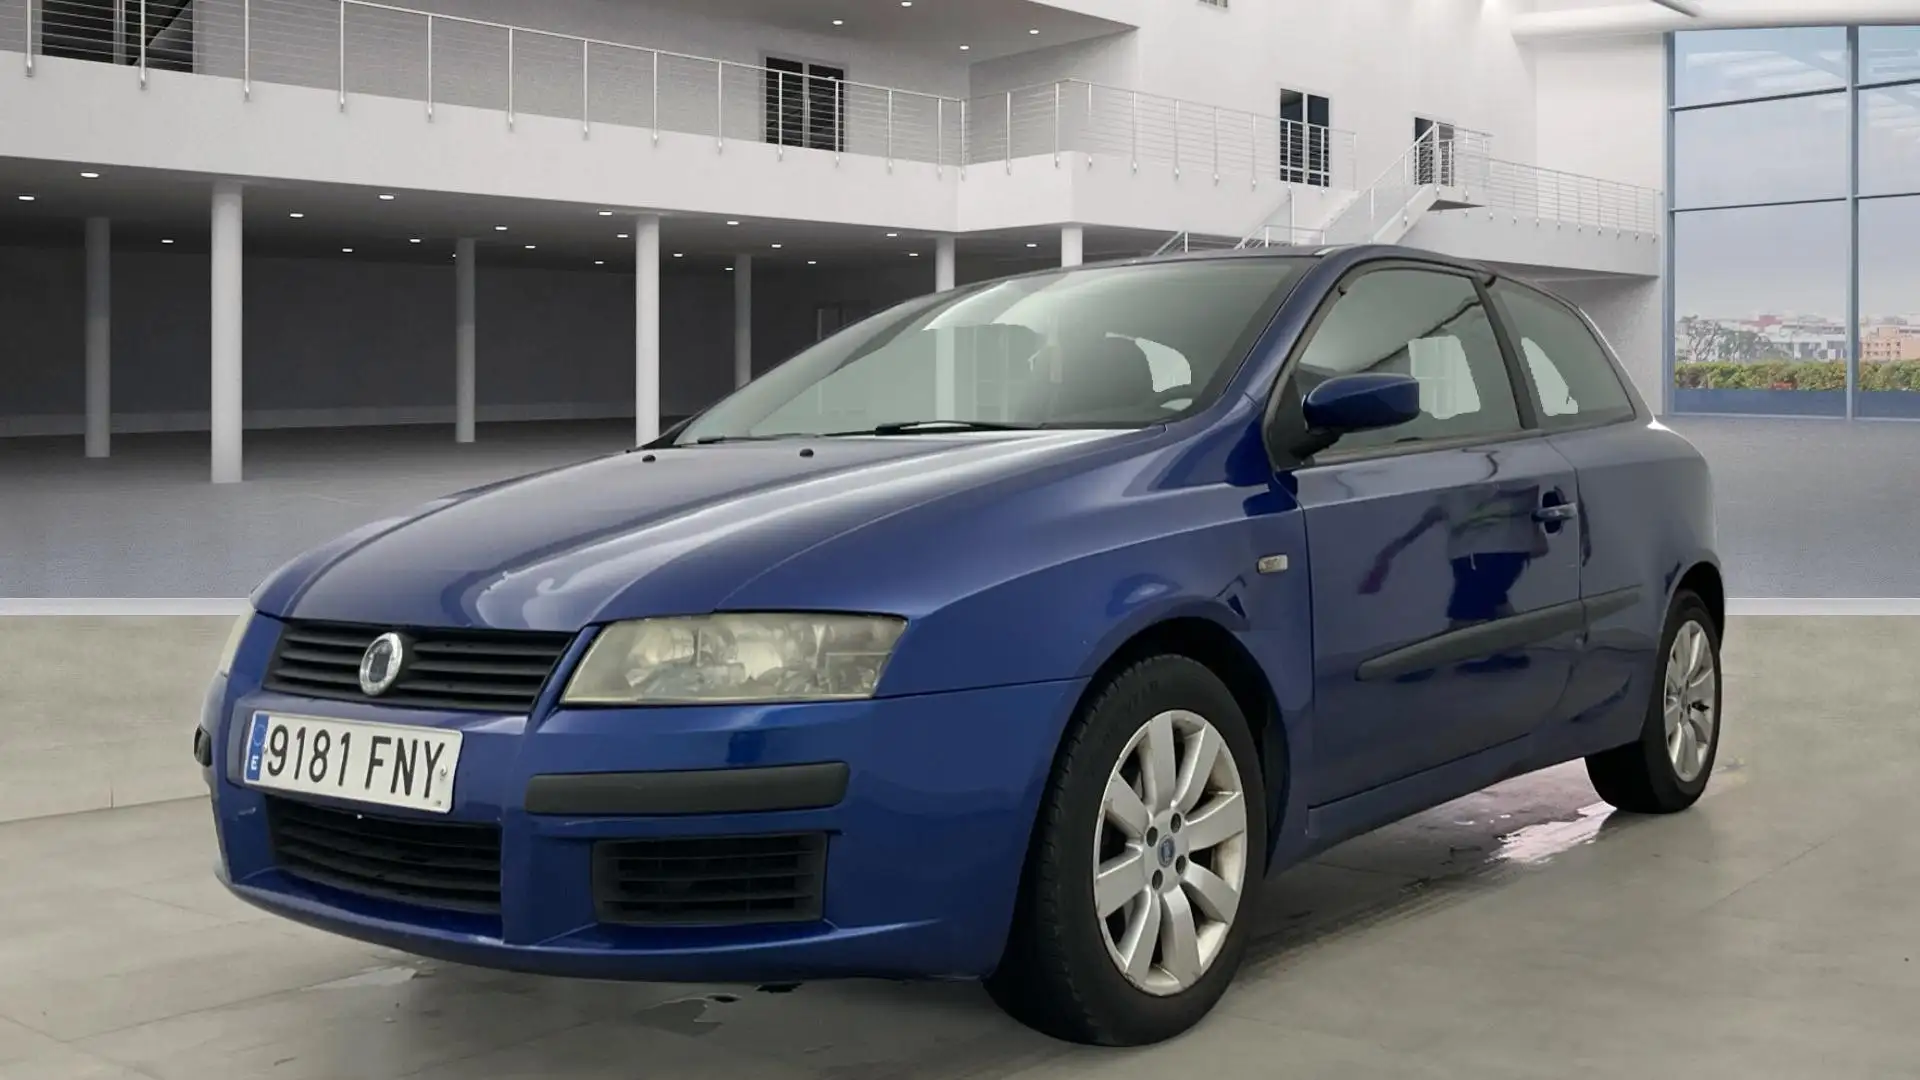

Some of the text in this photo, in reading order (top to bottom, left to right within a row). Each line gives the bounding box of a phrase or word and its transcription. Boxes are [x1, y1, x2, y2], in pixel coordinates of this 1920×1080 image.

[250, 755, 259, 771] E
[267, 724, 446, 799] 9181 FNY
